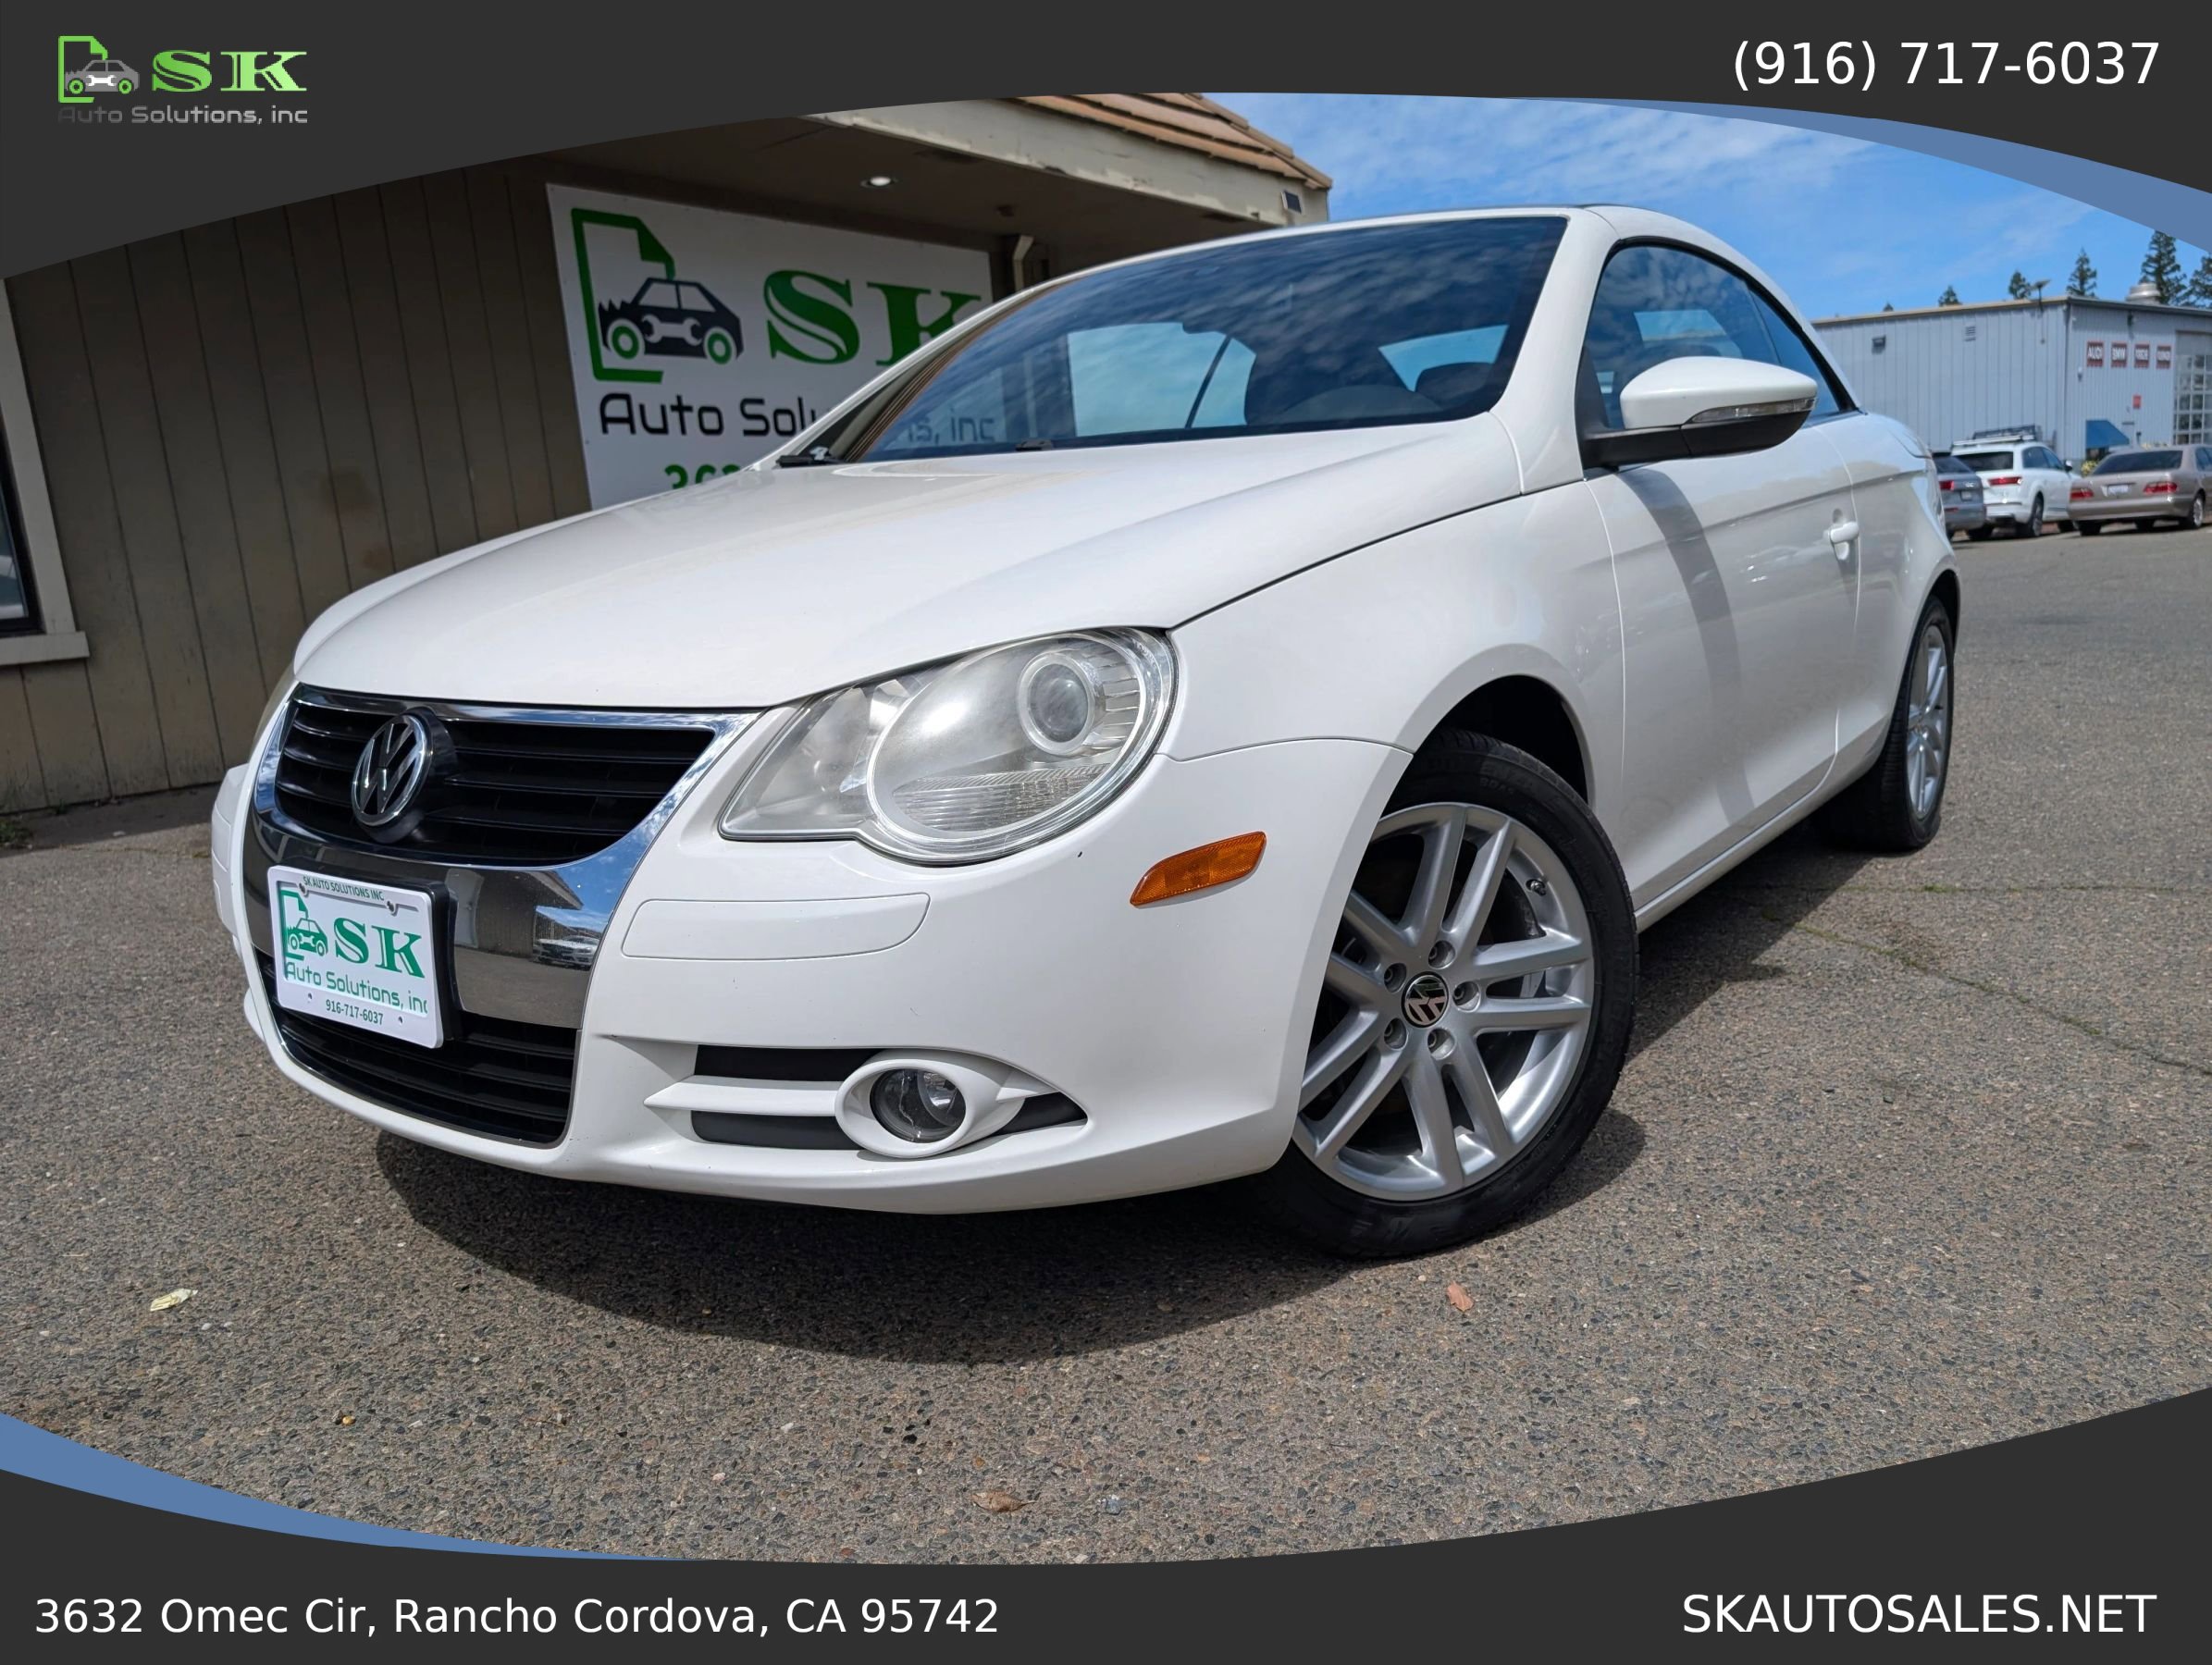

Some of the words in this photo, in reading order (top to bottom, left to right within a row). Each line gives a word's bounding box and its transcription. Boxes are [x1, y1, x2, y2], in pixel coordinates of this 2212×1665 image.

[763, 269, 982, 367] SK
[599, 392, 725, 437] Auto
[303, 875, 314, 886] SK
[313, 878, 330, 891] AUTO
[331, 882, 371, 898] SOLUTIONS
[371, 890, 385, 902] INC
[333, 917, 426, 979] SK
[285, 961, 322, 987] Auto
[326, 971, 404, 1011] Solutions,
[326, 999, 384, 1026] 916-717-6037
